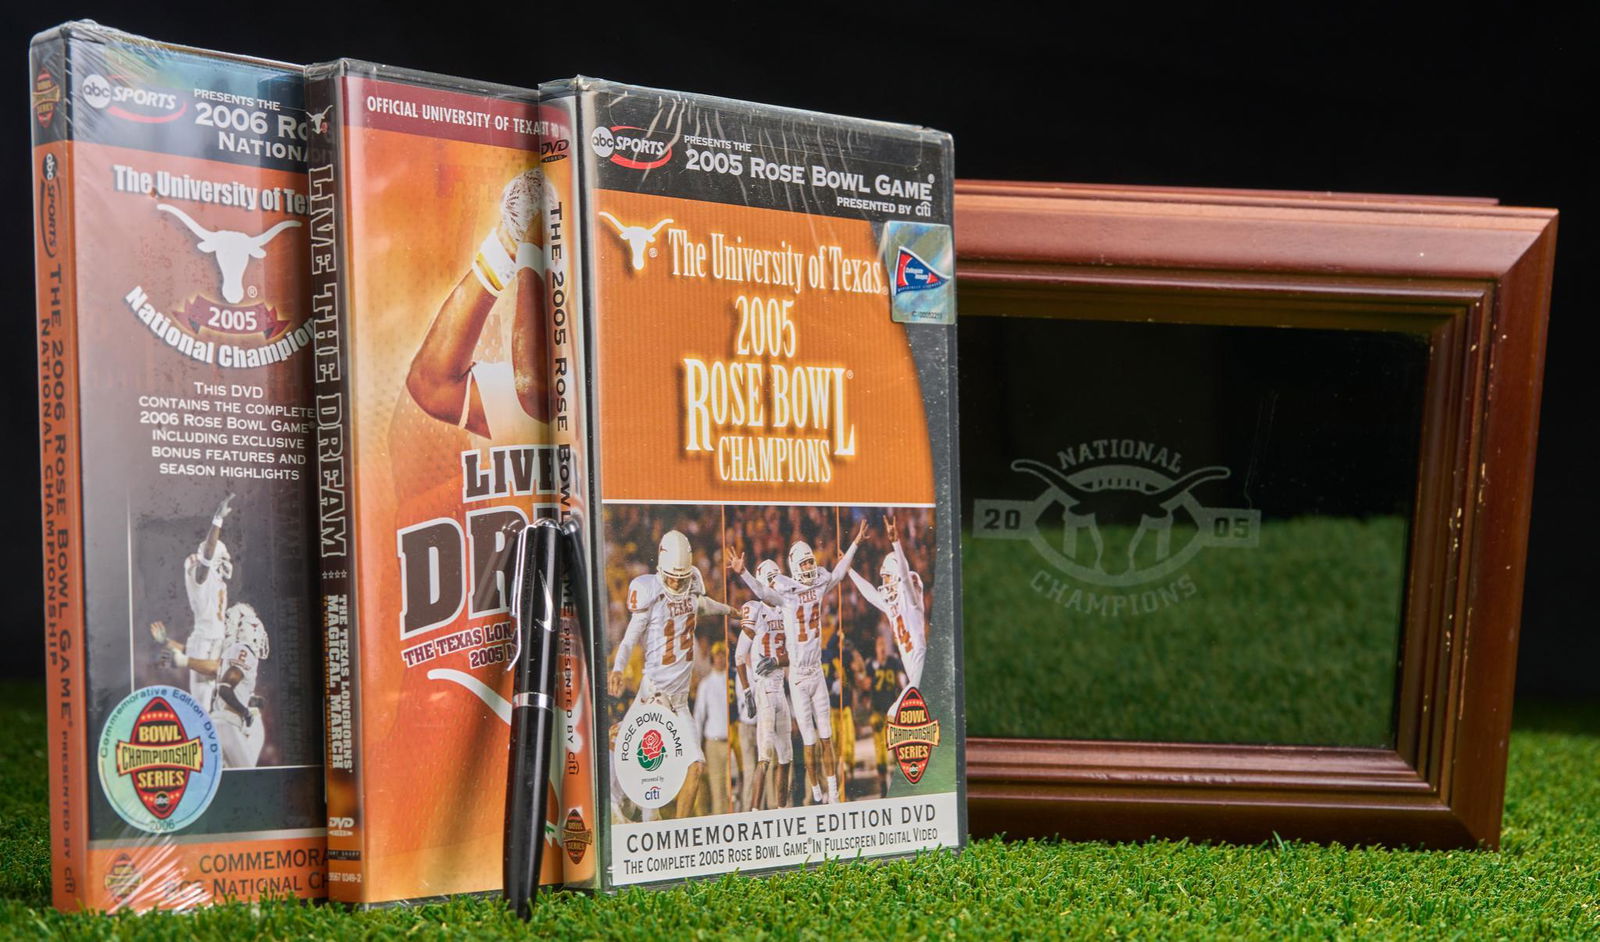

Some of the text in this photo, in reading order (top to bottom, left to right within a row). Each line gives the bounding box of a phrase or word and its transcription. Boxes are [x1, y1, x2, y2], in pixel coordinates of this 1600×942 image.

[84, 82, 110, 98] abc
[111, 87, 177, 110] SPORTS
[194, 88, 280, 111] PRESENTS THE
[367, 96, 418, 118] OFFICIAL
[422, 104, 490, 128] UNIVERSITY
[495, 115, 509, 131] OF
[195, 102, 268, 135] 2006
[541, 139, 569, 155] DVD
[592, 134, 665, 156] abc SPORTS
[684, 135, 752, 152] PRESENTS THE
[113, 164, 152, 193] The
[157, 171, 257, 211] University
[262, 188, 280, 212] of
[685, 149, 933, 201] 2005 ROSE BOWL GAME
[46, 153, 57, 248] abc SPORTS
[836, 197, 931, 217] PRESENTED BY citi
[550, 201, 563, 261] THE
[668, 228, 881, 294] The University of Texas
[125, 286, 214, 364] National
[208, 307, 257, 330] 2005
[552, 271, 567, 346] 2005
[735, 296, 796, 358] 2005
[310, 164, 346, 557] LIVE THE DREAM
[139, 396, 316, 418] CONTAINS THE COMPLETE
[194, 382, 263, 399] THIS DVD
[555, 357, 568, 432] ROSE
[684, 358, 855, 456] ROSE BOWL
[140, 411, 309, 434] 2006 ROSE BOWL GAME
[152, 430, 305, 449] INCLUDING EXCLUSIVE
[151, 446, 306, 465] BONUS FEATURES AND
[159, 463, 300, 480] SEASON HIGHLIGHTS
[718, 436, 832, 483] CHAMPIONS
[1057, 439, 1182, 474] NATIONAL
[41, 319, 57, 665] NATIONAL CHAMPIONSHIP
[50, 264, 72, 720] THE 2006 ROSE BOWL GAME
[558, 444, 571, 526] BOWL
[984, 509, 1249, 538] 20 05
[338, 594, 348, 625] THE
[668, 600, 694, 617] TEXAS
[1030, 569, 1197, 617] CHAMPIONS
[662, 614, 696, 665] 14
[796, 603, 820, 643] 14
[340, 629, 350, 677] TEXAS
[401, 641, 436, 667] THE
[434, 627, 483, 656] TEXAS
[469, 645, 503, 668] 2005
[328, 595, 344, 769] MAGICAL MARCH
[874, 670, 895, 691] 79
[564, 628, 579, 775] PRESENTED BY citi
[900, 710, 927, 723] BOWL
[139, 725, 182, 742] BOWL
[172, 689, 204, 718] Edition
[204, 721, 219, 753] DVD
[621, 712, 683, 761] ROSE BOWL GAME
[122, 742, 198, 770] CHAMPIONSHIP
[899, 745, 928, 759] SERIES
[138, 770, 184, 788] SERIES
[645, 786, 660, 800] citi
[328, 817, 355, 829] DVD
[627, 804, 936, 853] COMMEMORATIVE EDITION DVD
[624, 827, 938, 874] THE COMPLETE 2005 ROSE BOWL GAME IN FULLSCREEN DIGITAL VIDEO
[213, 877, 303, 897] NATIONAL
